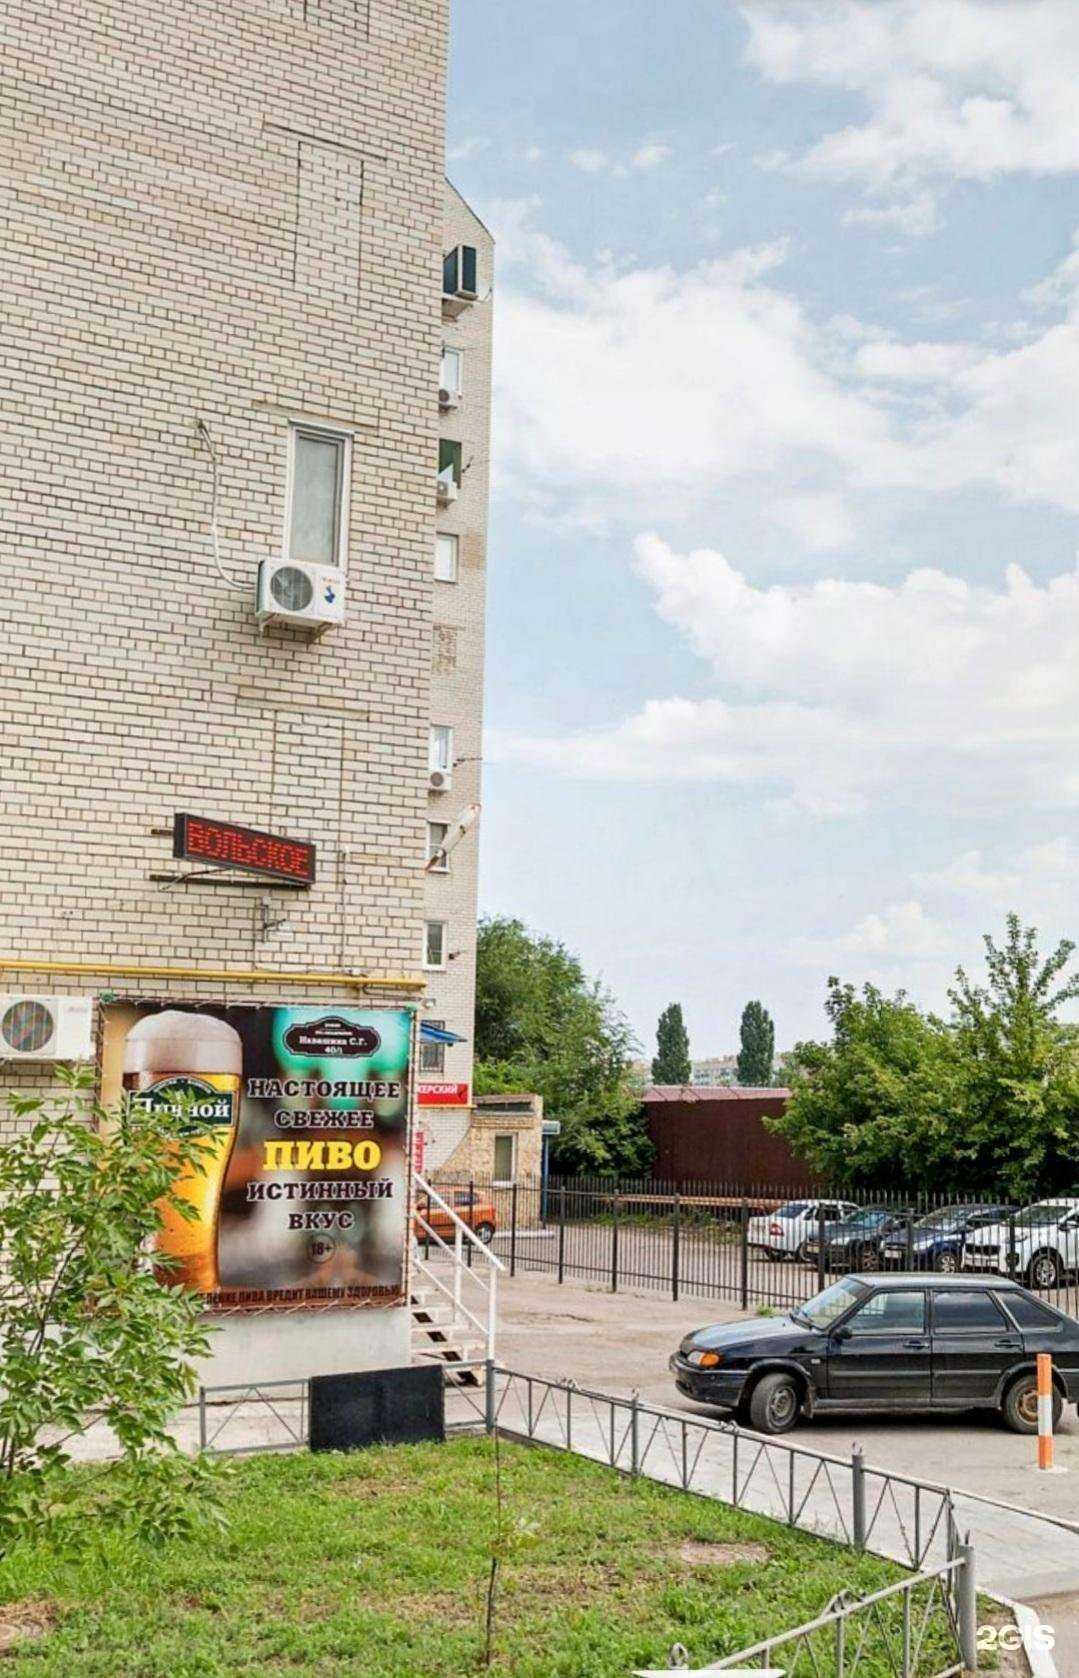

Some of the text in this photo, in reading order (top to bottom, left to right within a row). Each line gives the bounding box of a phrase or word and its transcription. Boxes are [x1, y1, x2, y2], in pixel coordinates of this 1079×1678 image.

[247, 1077, 401, 1101] НАСТОЯЩЕЕ
[274, 1109, 374, 1129] СВЕЖЕЕ
[263, 1140, 382, 1171] ПИВО
[247, 1178, 394, 1202] ИСТИННЫЙ
[288, 1211, 354, 1231] ВКУС
[311, 1242, 332, 1257] 18+
[266, 1287, 303, 1302] ВРЕДИТ
[305, 1286, 345, 1299] ВАШЕМУ
[347, 1284, 400, 1299] ЗДОРОВЬЮ
